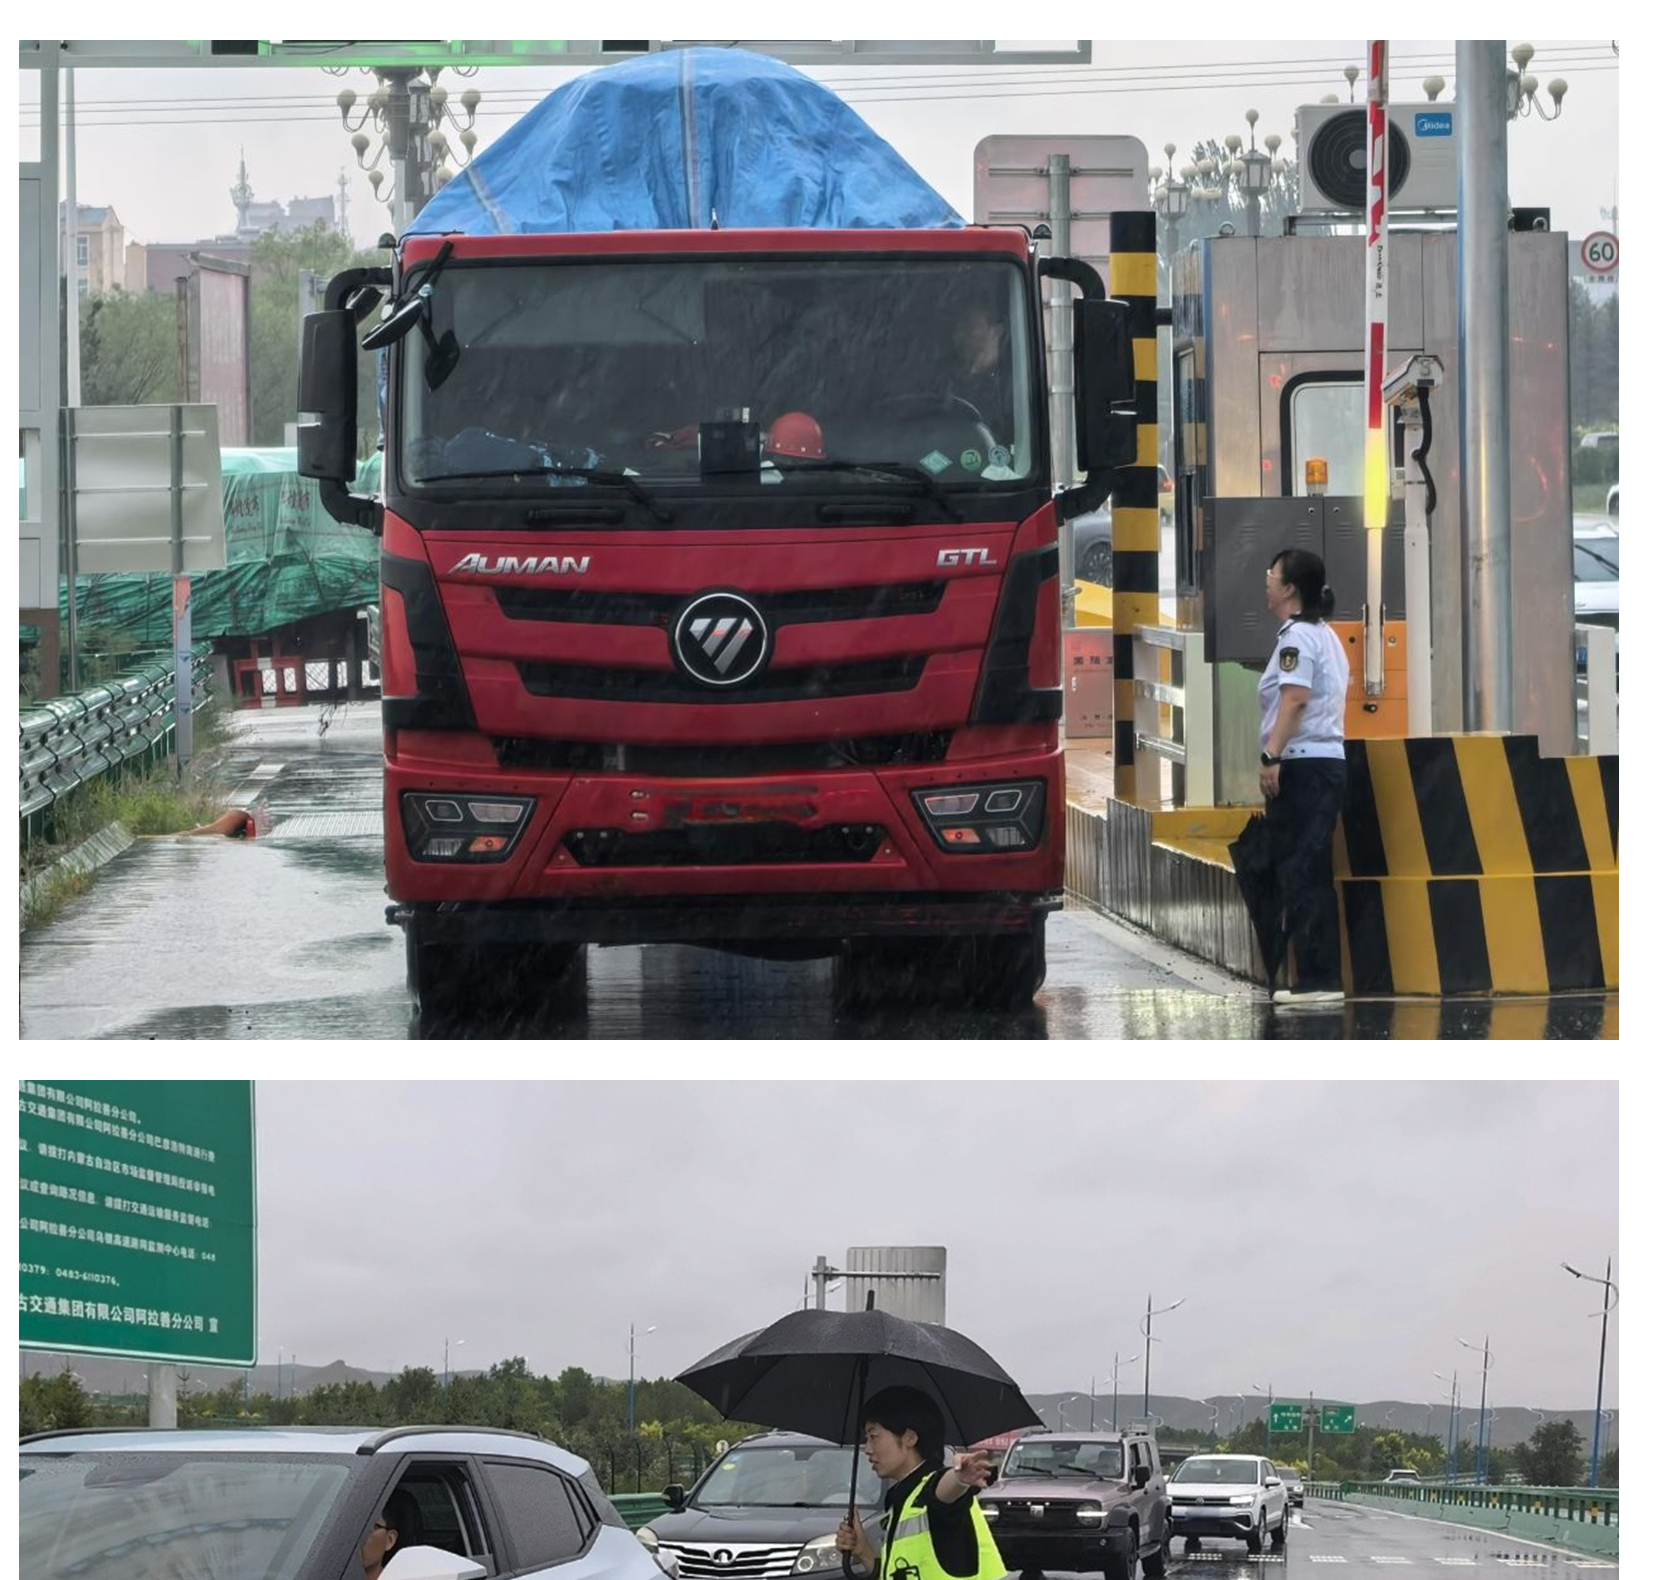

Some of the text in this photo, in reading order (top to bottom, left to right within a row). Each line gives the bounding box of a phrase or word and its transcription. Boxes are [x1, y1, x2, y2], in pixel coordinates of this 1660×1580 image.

[1589, 242, 1614, 262] 60
[447, 553, 590, 575] AUMAN
[937, 548, 997, 567] GTL
